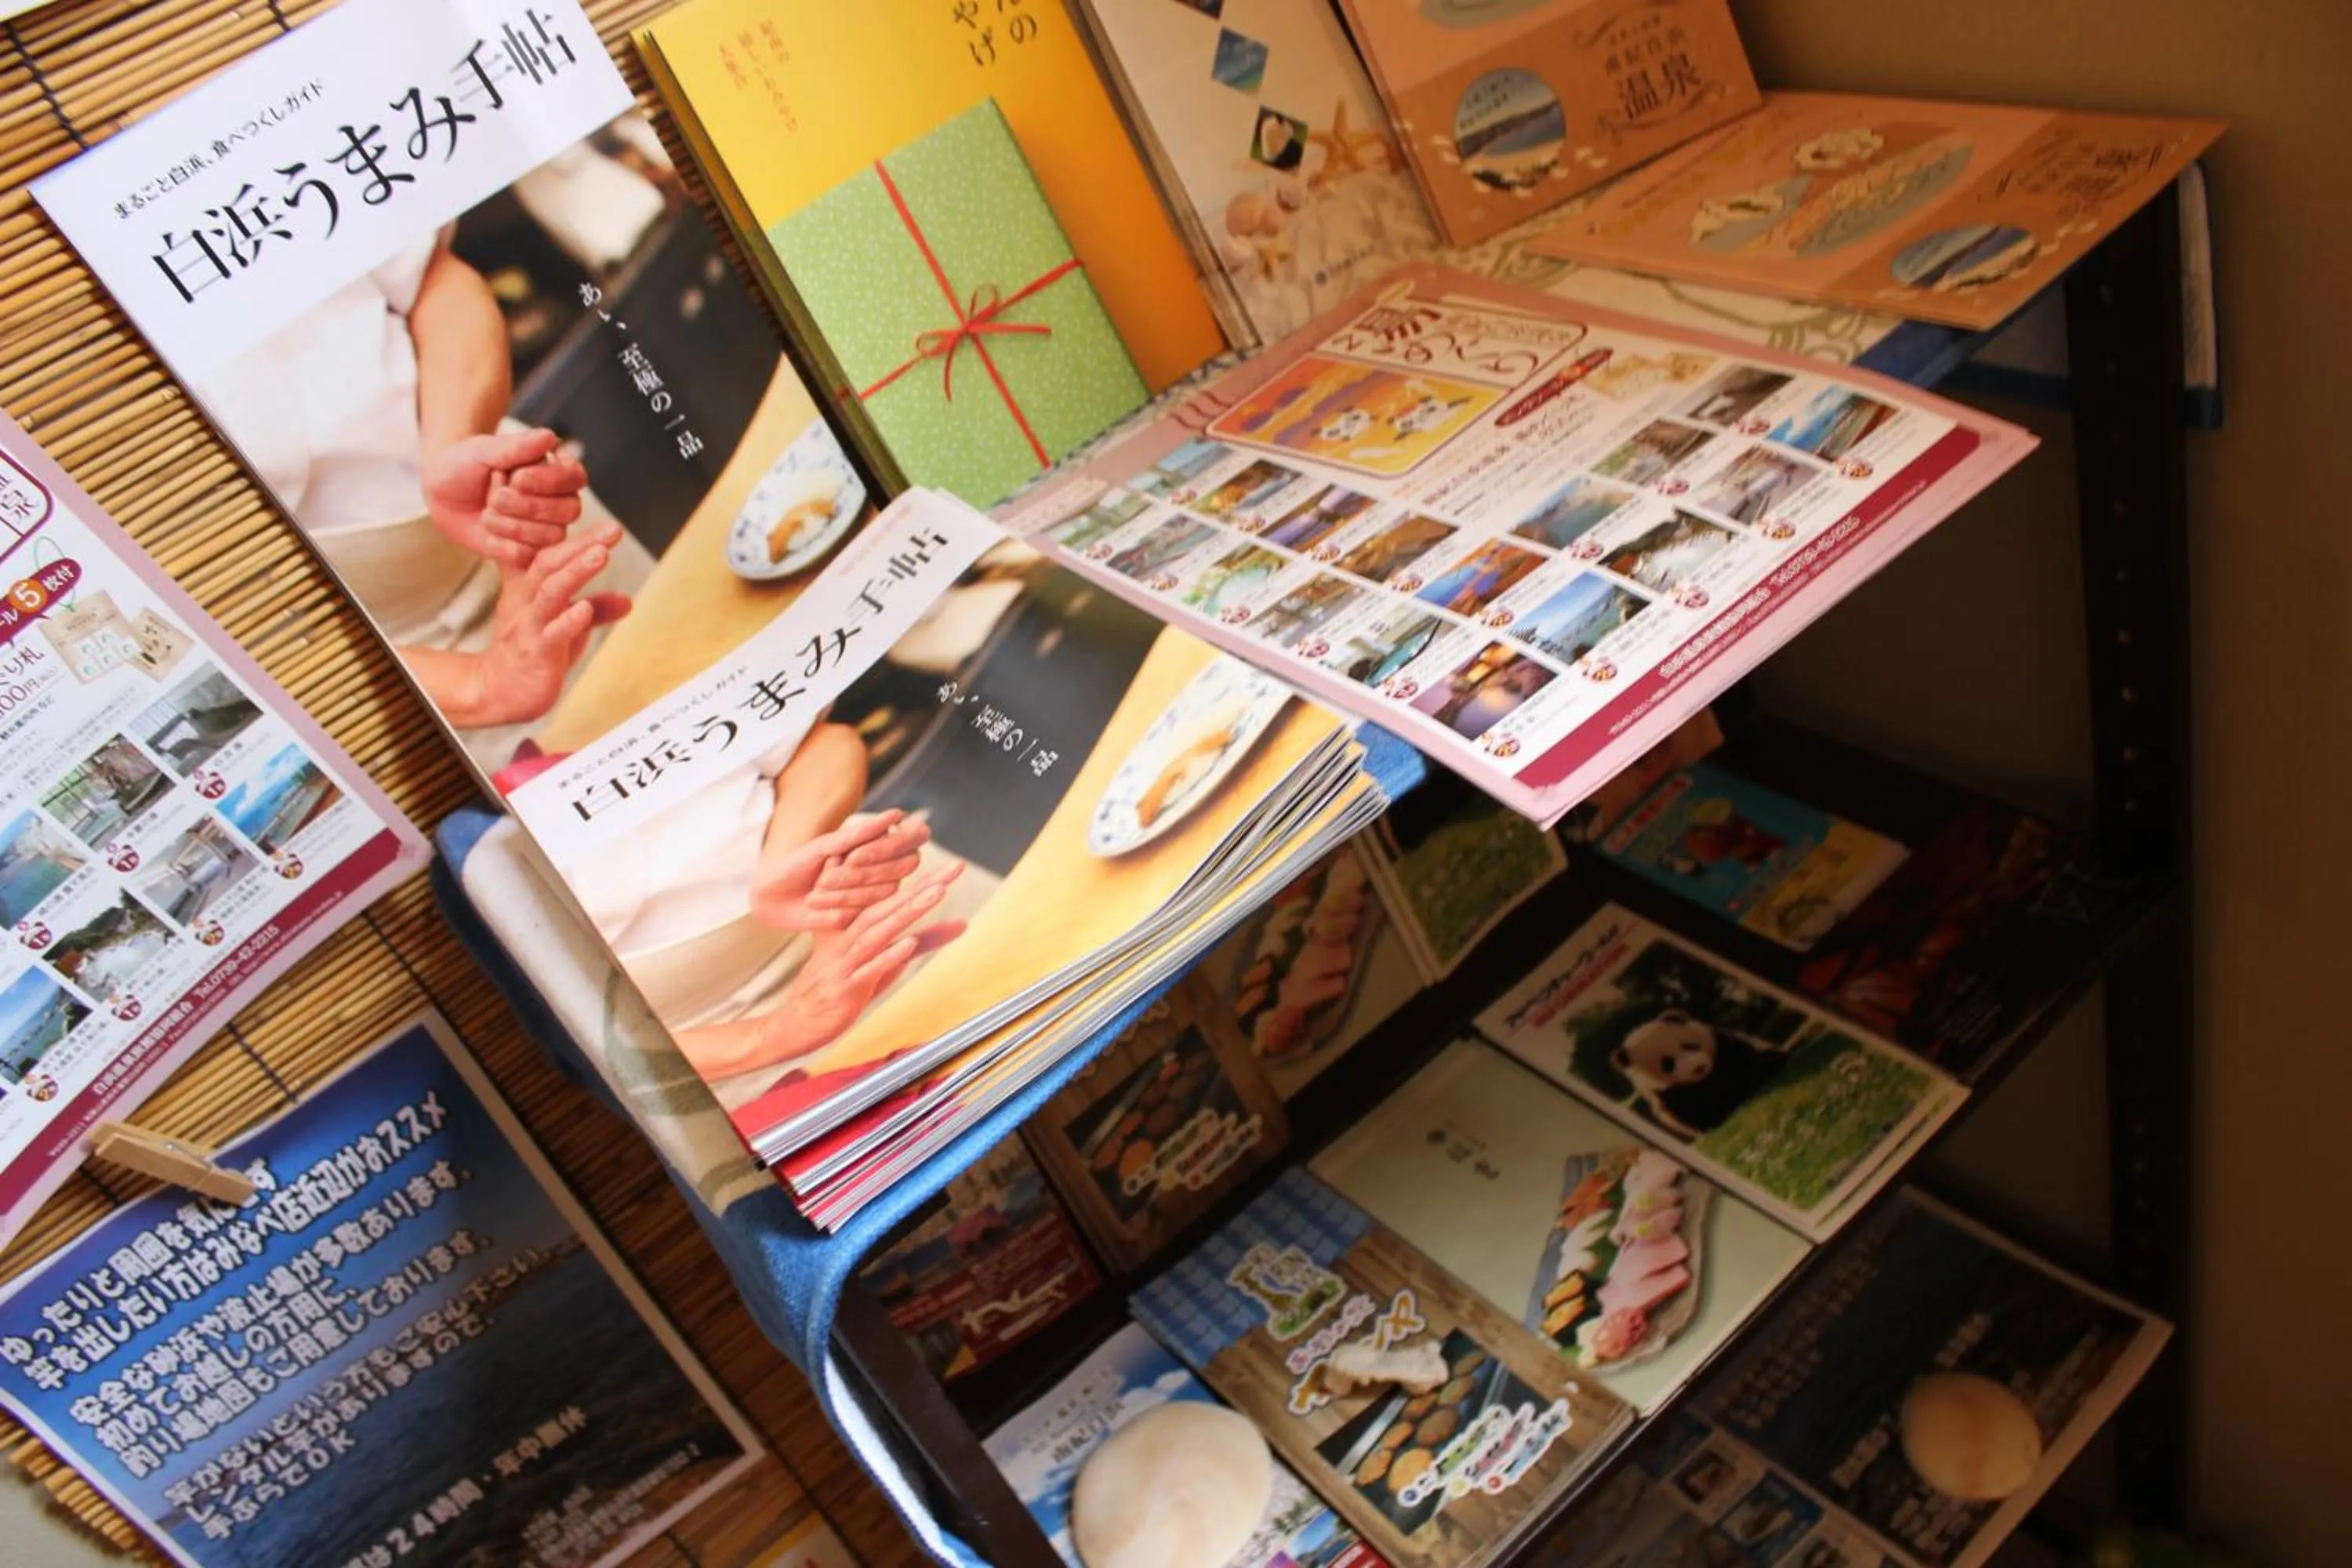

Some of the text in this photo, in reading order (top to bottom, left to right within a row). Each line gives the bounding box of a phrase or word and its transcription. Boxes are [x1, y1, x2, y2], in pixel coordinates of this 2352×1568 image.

[113, 80, 325, 220] まるごと白浜、食べつくしガイド
[153, 8, 577, 303] 白浜うまみ手帖
[1617, 51, 1700, 121] 温泉
[572, 528, 949, 822] 白浜うまみ手帖
[1, 1156, 277, 1365] ゆったりと周囲を気にず
